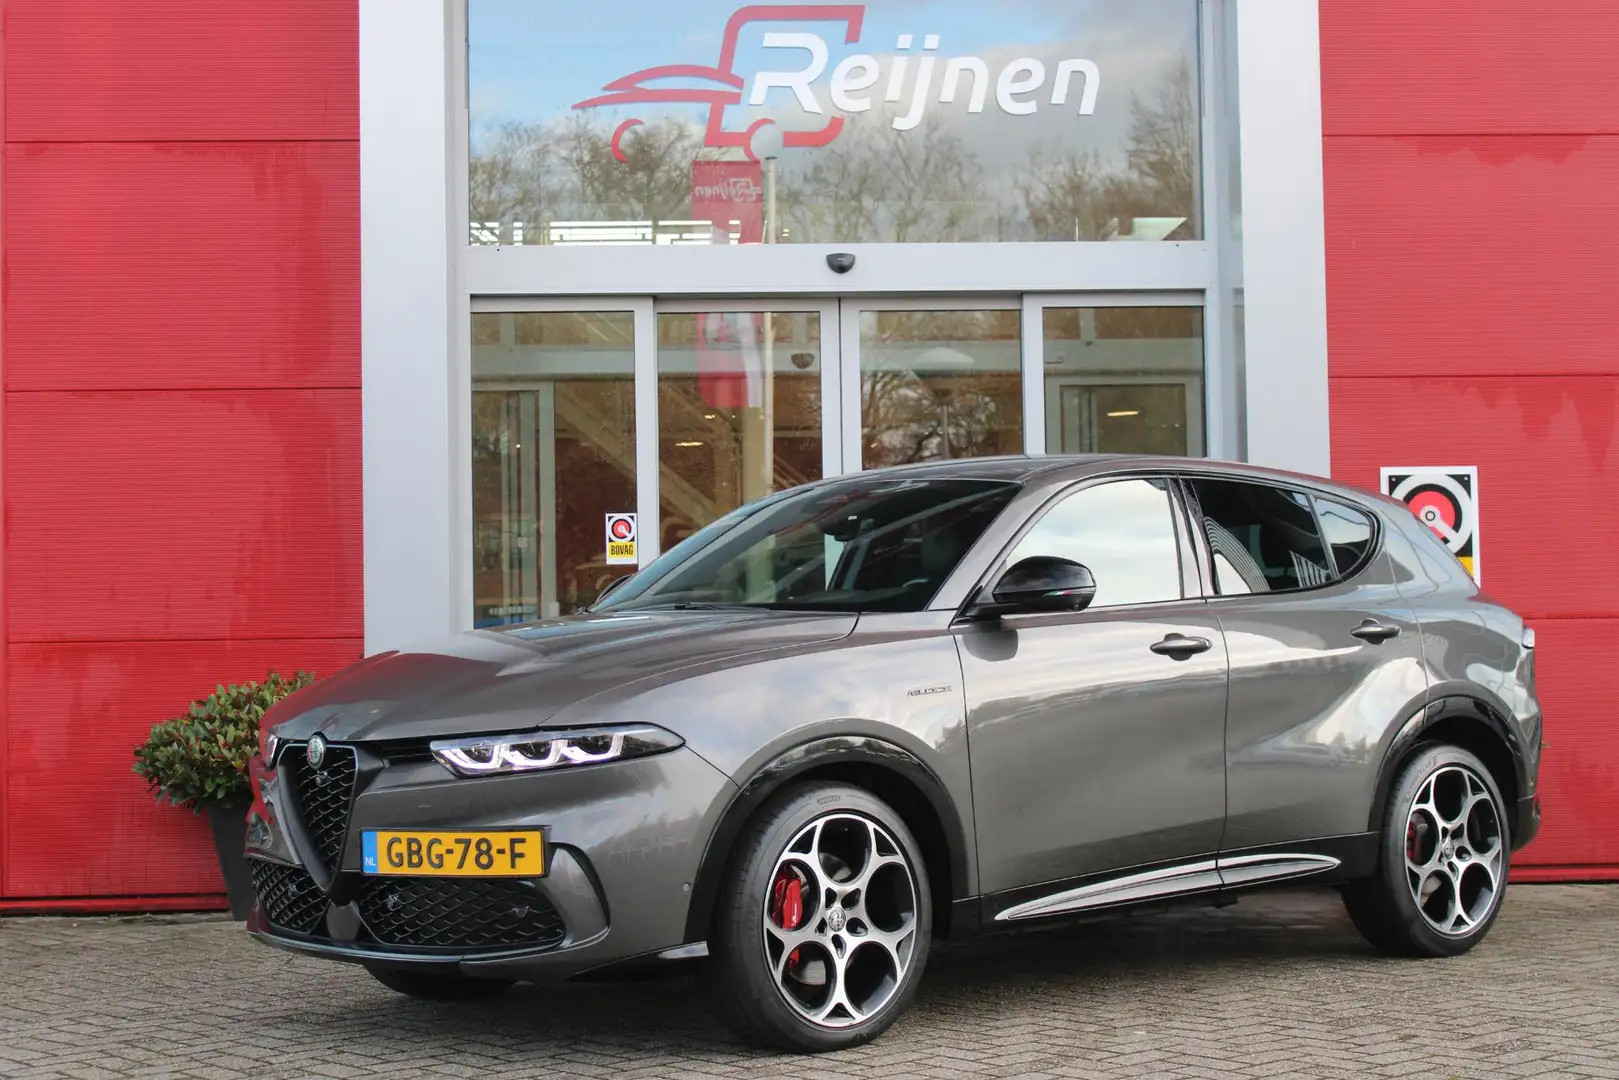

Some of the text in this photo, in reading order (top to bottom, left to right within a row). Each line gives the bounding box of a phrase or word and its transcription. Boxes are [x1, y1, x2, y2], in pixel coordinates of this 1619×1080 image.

[749, 33, 1100, 130] Reijnen
[610, 545, 634, 556] BOVAG
[365, 857, 376, 867] NL
[386, 837, 526, 870] GBG-78-F
